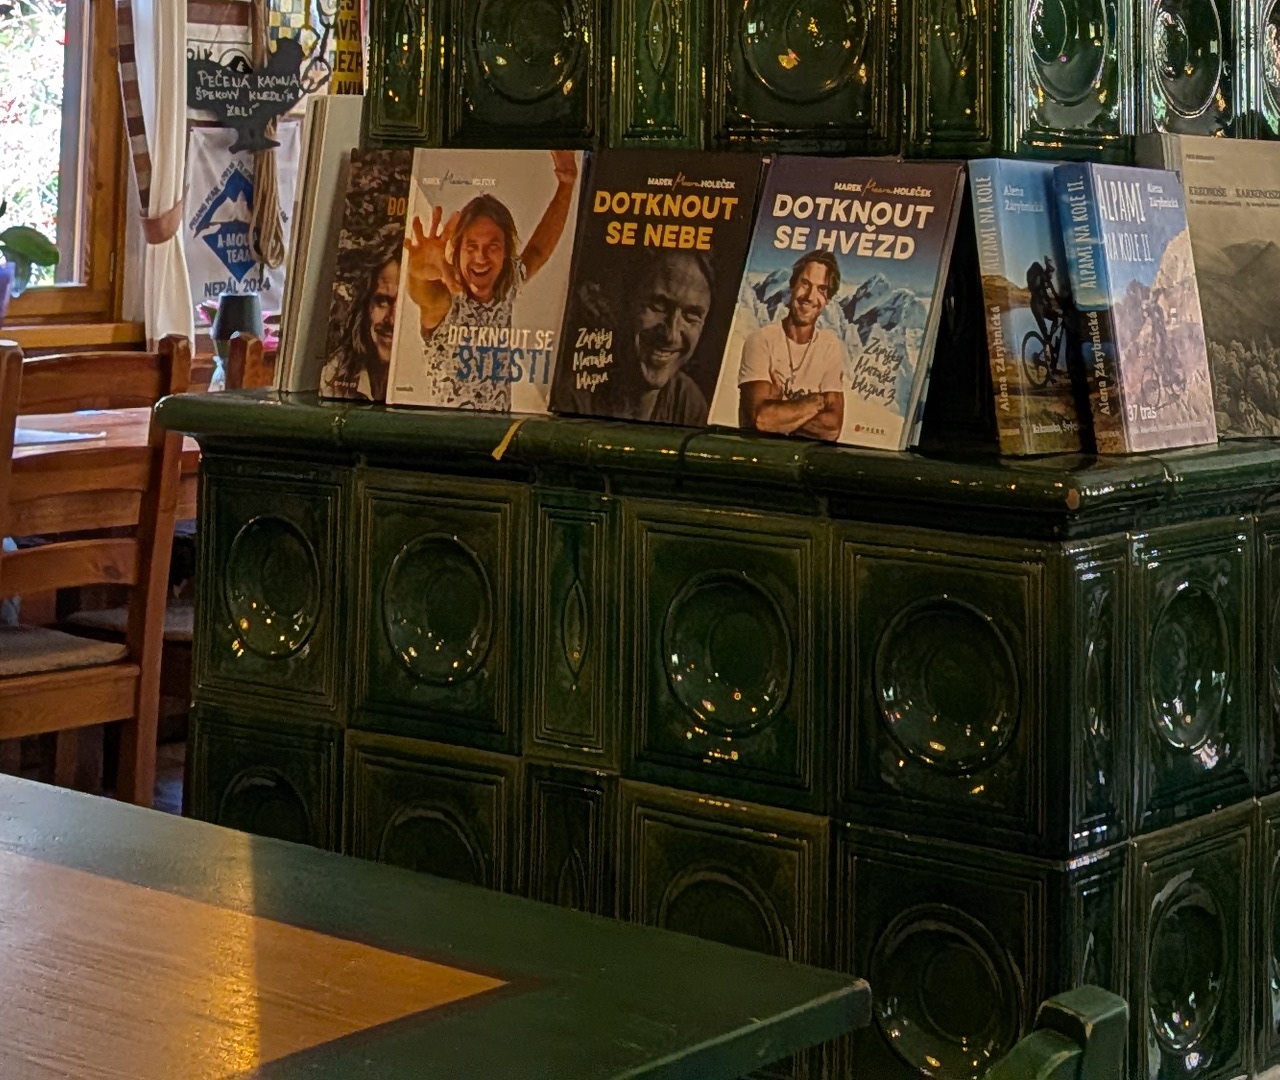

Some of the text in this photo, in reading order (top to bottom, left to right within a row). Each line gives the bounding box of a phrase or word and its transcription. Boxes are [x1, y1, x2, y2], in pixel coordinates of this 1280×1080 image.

[647, 177, 673, 187] MAREK
[700, 177, 736, 190] HOLEČEK
[833, 181, 862, 193] MAREK
[893, 185, 932, 198] HOLEČEK
[386, 196, 409, 217] DO
[593, 190, 739, 220] DOTKNOUT
[772, 193, 935, 229] DOTKNOUT
[1097, 175, 1146, 225] ALPAMI
[605, 221, 714, 251] SE NEBE
[975, 175, 1000, 271] ALPAMI NA KOLE
[1067, 175, 1098, 289] ALPAMI NA KOLE II.
[773, 224, 916, 261] SE HVĚZD
[1104, 232, 1119, 261] NA
[1118, 232, 1142, 262] KOLE
[204, 276, 271, 297] NEPÁL 2014
[447, 324, 556, 352] DOTKNOUT SE
[990, 305, 1007, 373] Zárybnická
[1085, 311, 1108, 378] Zárybnická
[883, 388, 897, 407] 3
[996, 376, 1010, 412] Alena
[1096, 380, 1111, 416] Alena
[1127, 404, 1138, 422] 37
